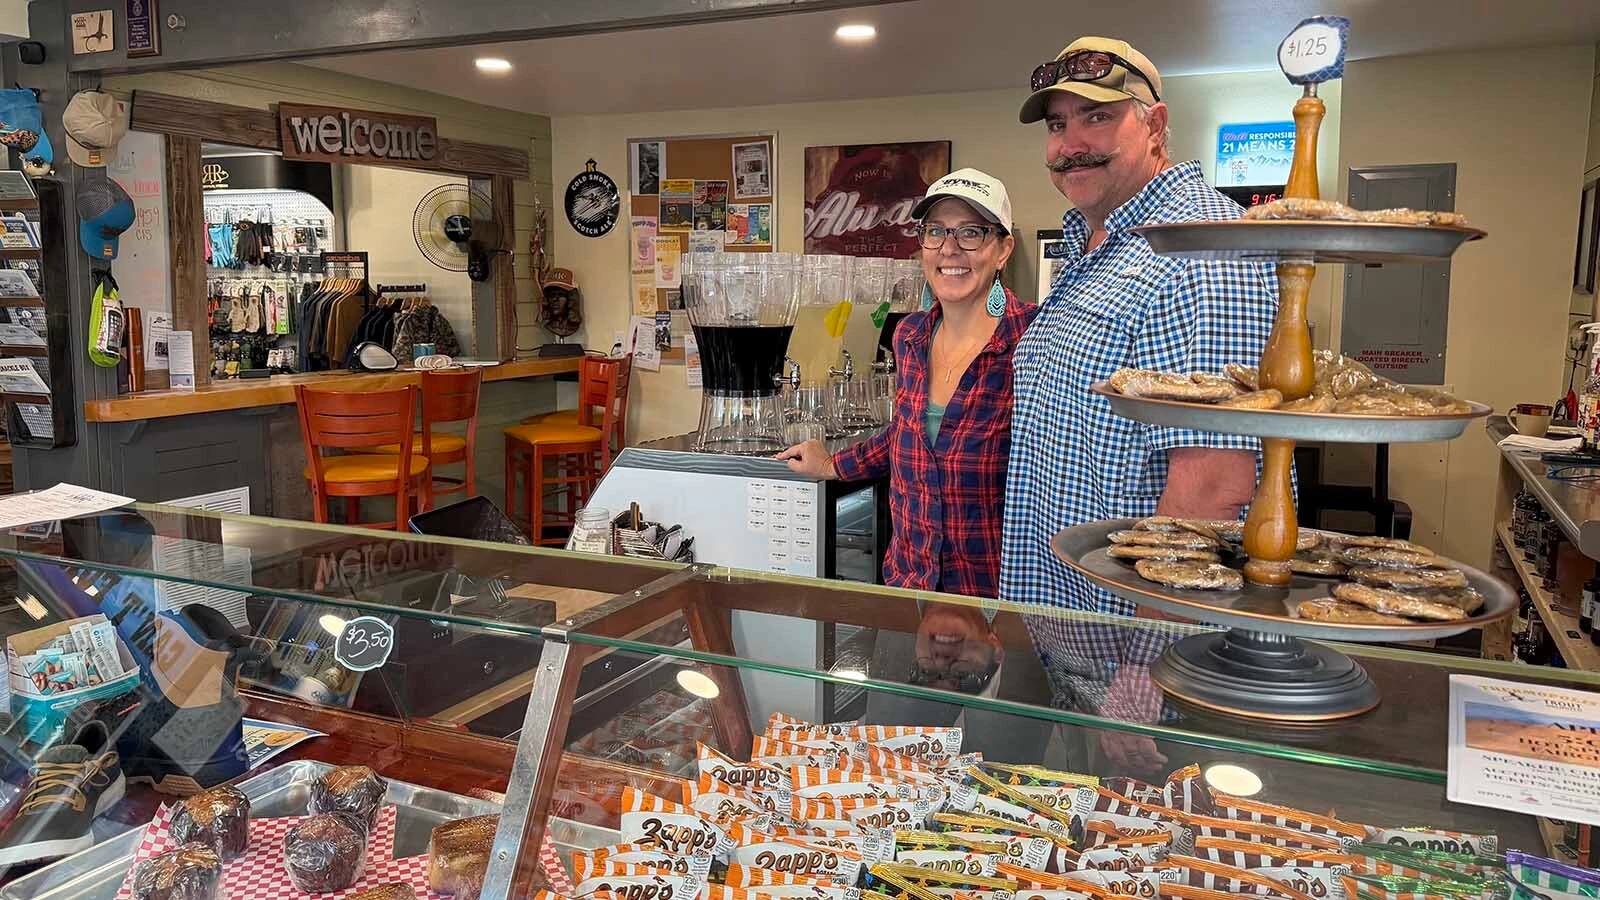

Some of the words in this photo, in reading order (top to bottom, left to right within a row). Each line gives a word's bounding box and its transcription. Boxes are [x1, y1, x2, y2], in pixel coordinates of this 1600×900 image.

[1287, 36, 1327, 58] $1.25
[291, 111, 437, 159] welcome
[1249, 131, 1297, 140] RESPONSIBL
[1222, 143, 1235, 153] 21
[1236, 141, 1286, 152] MEANS
[1289, 140, 1296, 149] 2
[855, 168, 881, 182] NOW
[571, 175, 587, 191] COLD
[589, 174, 613, 188] SMOKE
[573, 219, 599, 234] SCOTCH
[600, 220, 613, 232] ALE
[845, 243, 897, 253] PERFECT
[345, 627, 389, 658] $3.50
[1544, 699, 1582, 709] TROUT
[893, 733, 944, 757] app's
[1051, 822, 1063, 831] 220
[634, 818, 717, 856] Zapp's
[1036, 838, 1048, 846] 220
[1344, 838, 1358, 847] 220
[846, 888, 858, 897] 230
